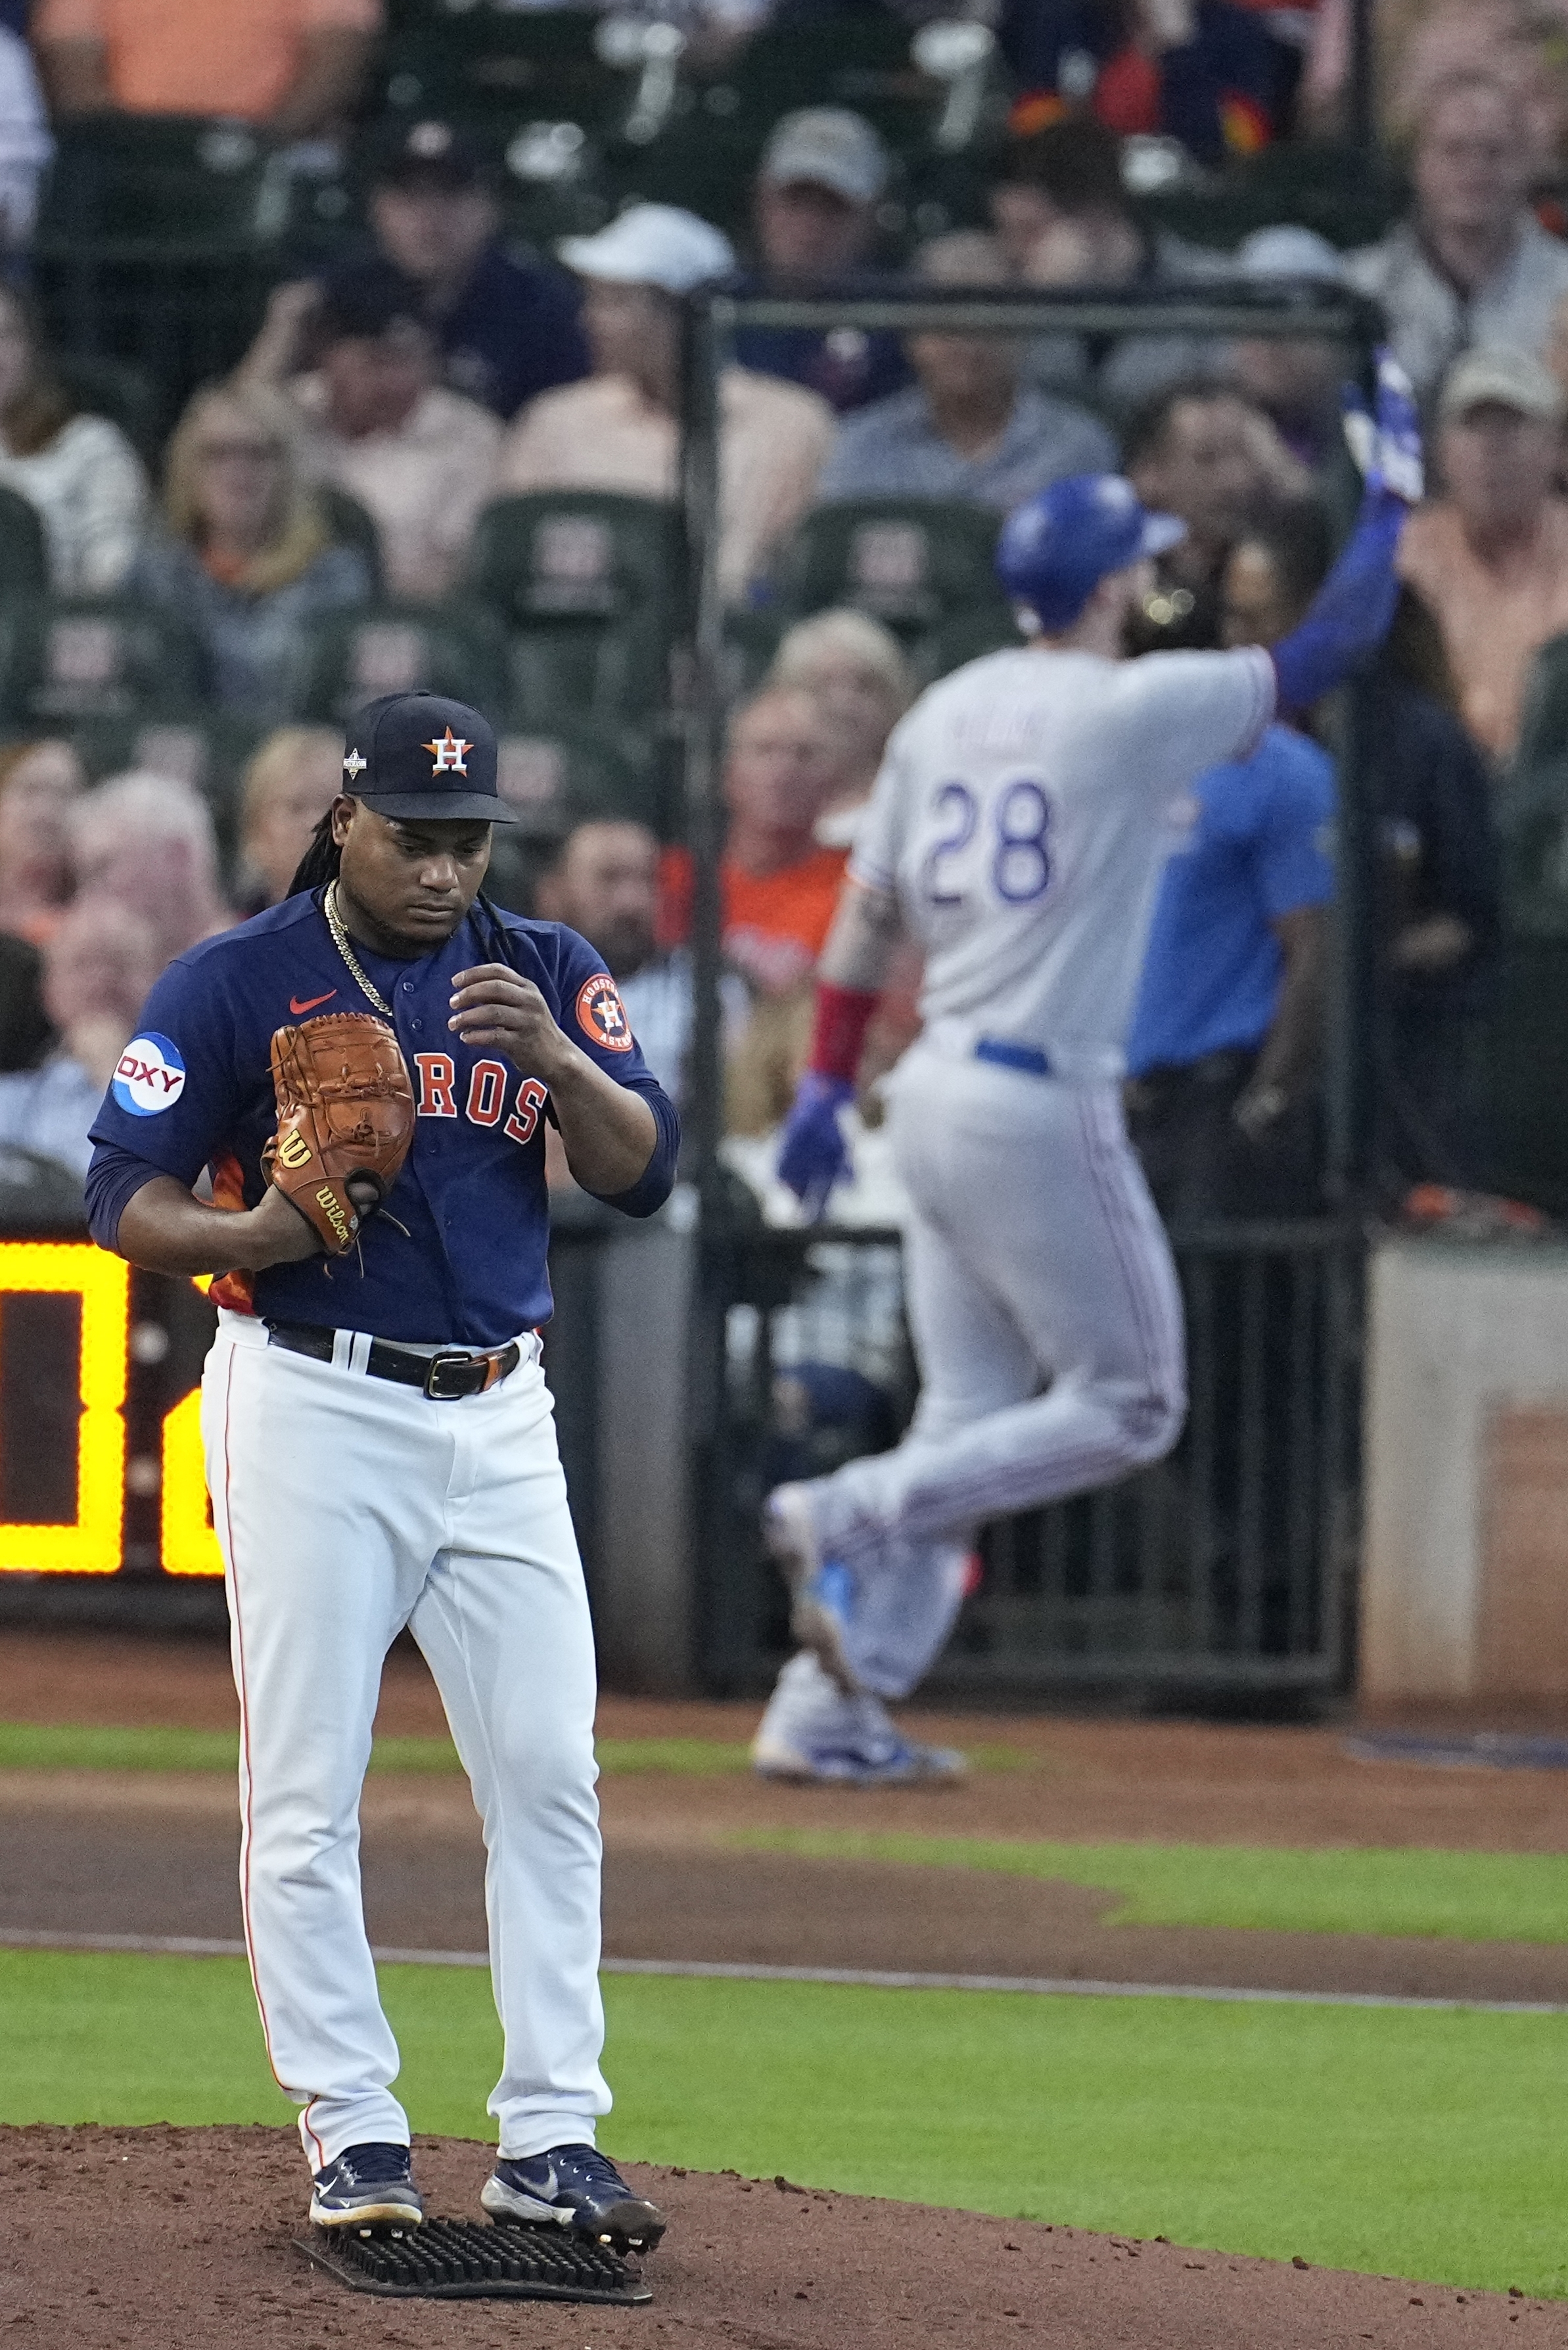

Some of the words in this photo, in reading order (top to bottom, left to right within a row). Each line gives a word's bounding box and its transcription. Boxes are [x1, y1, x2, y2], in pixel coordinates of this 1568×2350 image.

[432, 739, 467, 771] H
[921, 779, 1051, 906] 28
[582, 979, 619, 1005] HOUSTON
[597, 1000, 623, 1028] H
[117, 1055, 183, 1093] OXY
[315, 1185, 350, 1245] Wilson
